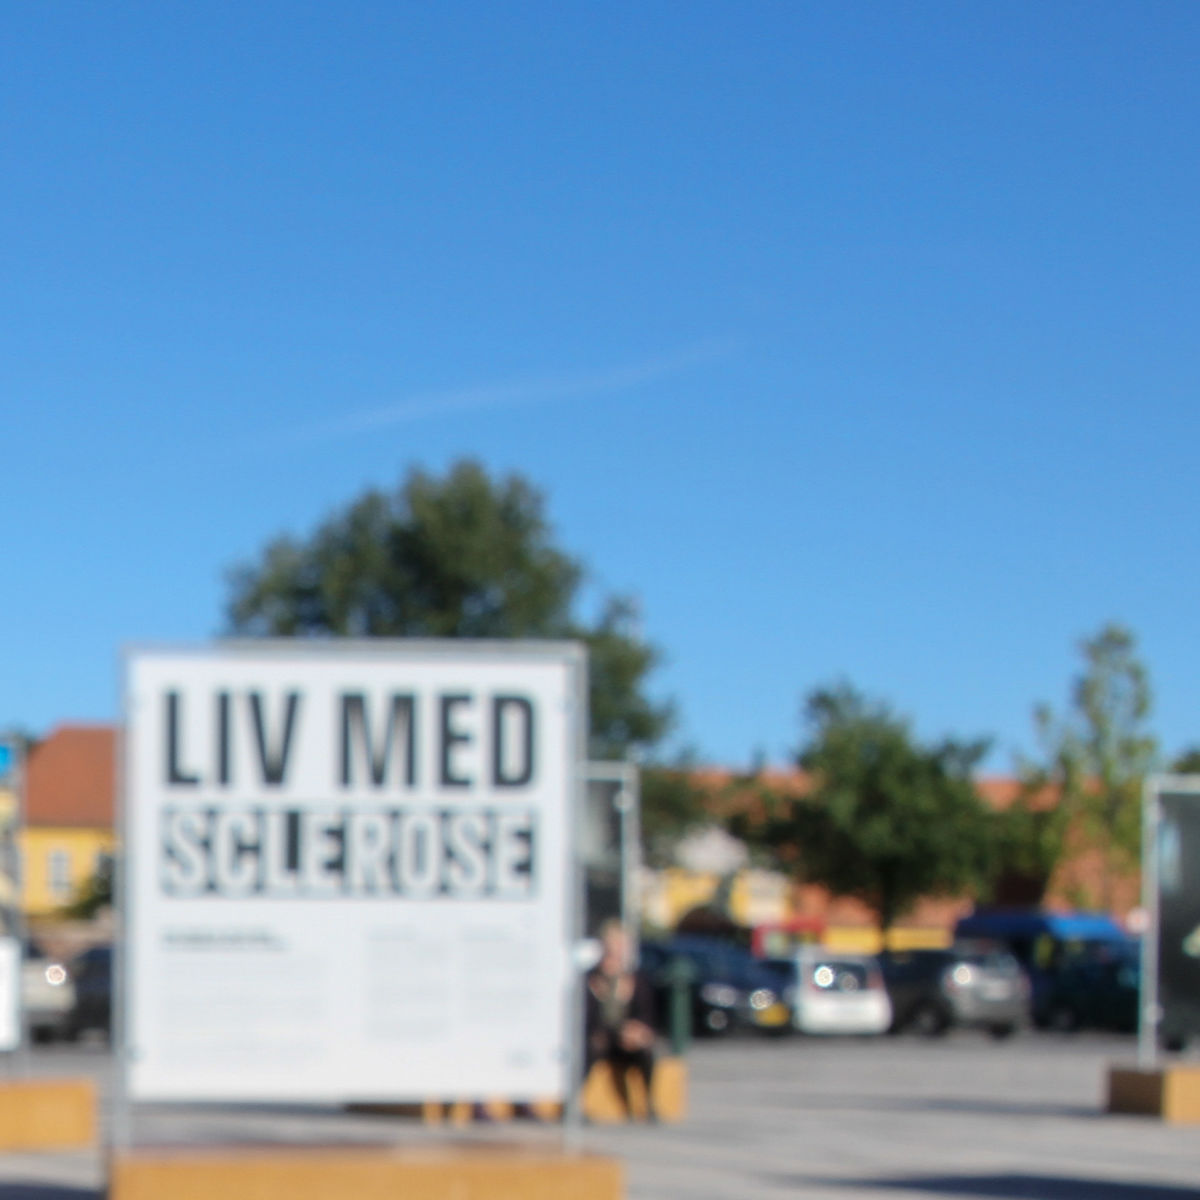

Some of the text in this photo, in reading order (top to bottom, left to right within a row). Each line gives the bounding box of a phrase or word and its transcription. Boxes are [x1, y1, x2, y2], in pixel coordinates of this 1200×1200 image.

[164, 689, 538, 788] LIV MED
[161, 804, 538, 898] SCLEROSE
